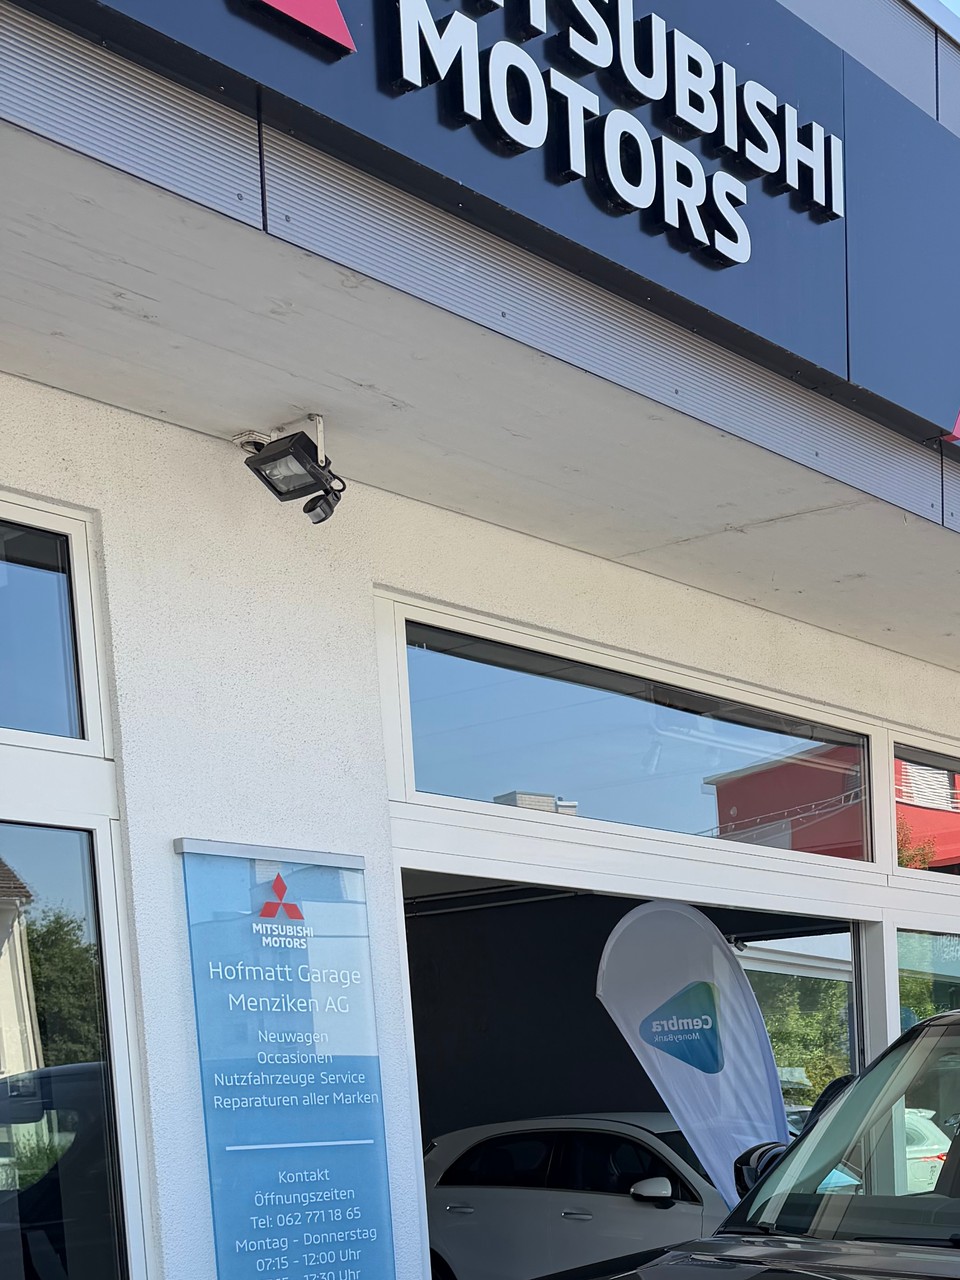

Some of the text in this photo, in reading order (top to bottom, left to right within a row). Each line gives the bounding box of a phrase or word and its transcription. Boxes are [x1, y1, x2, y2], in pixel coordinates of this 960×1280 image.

[401, 0, 751, 263] MOTORS
[252, 923, 313, 937] MITSUBISHI
[262, 937, 306, 948] MOTORS
[209, 961, 360, 987] Hofmatt Garage
[228, 994, 349, 1012] Menziken AG
[258, 1030, 328, 1045] Neuwagen
[258, 1052, 332, 1064] Occasionen
[214, 1072, 365, 1087] Nutzfahrzeuge Service
[214, 1092, 378, 1110] Reparaturen aller Marken
[278, 1168, 330, 1183] Kontakt
[255, 1188, 354, 1206] Öffnungszeiten
[250, 1207, 361, 1229] Tel: 062 771 18 65
[236, 1236, 288, 1252] Montag
[304, 1227, 377, 1246] Donnerstag
[256, 1256, 288, 1272] 07:15
[303, 1251, 335, 1266] 12:00
[340, 1248, 361, 1262] Uhr
